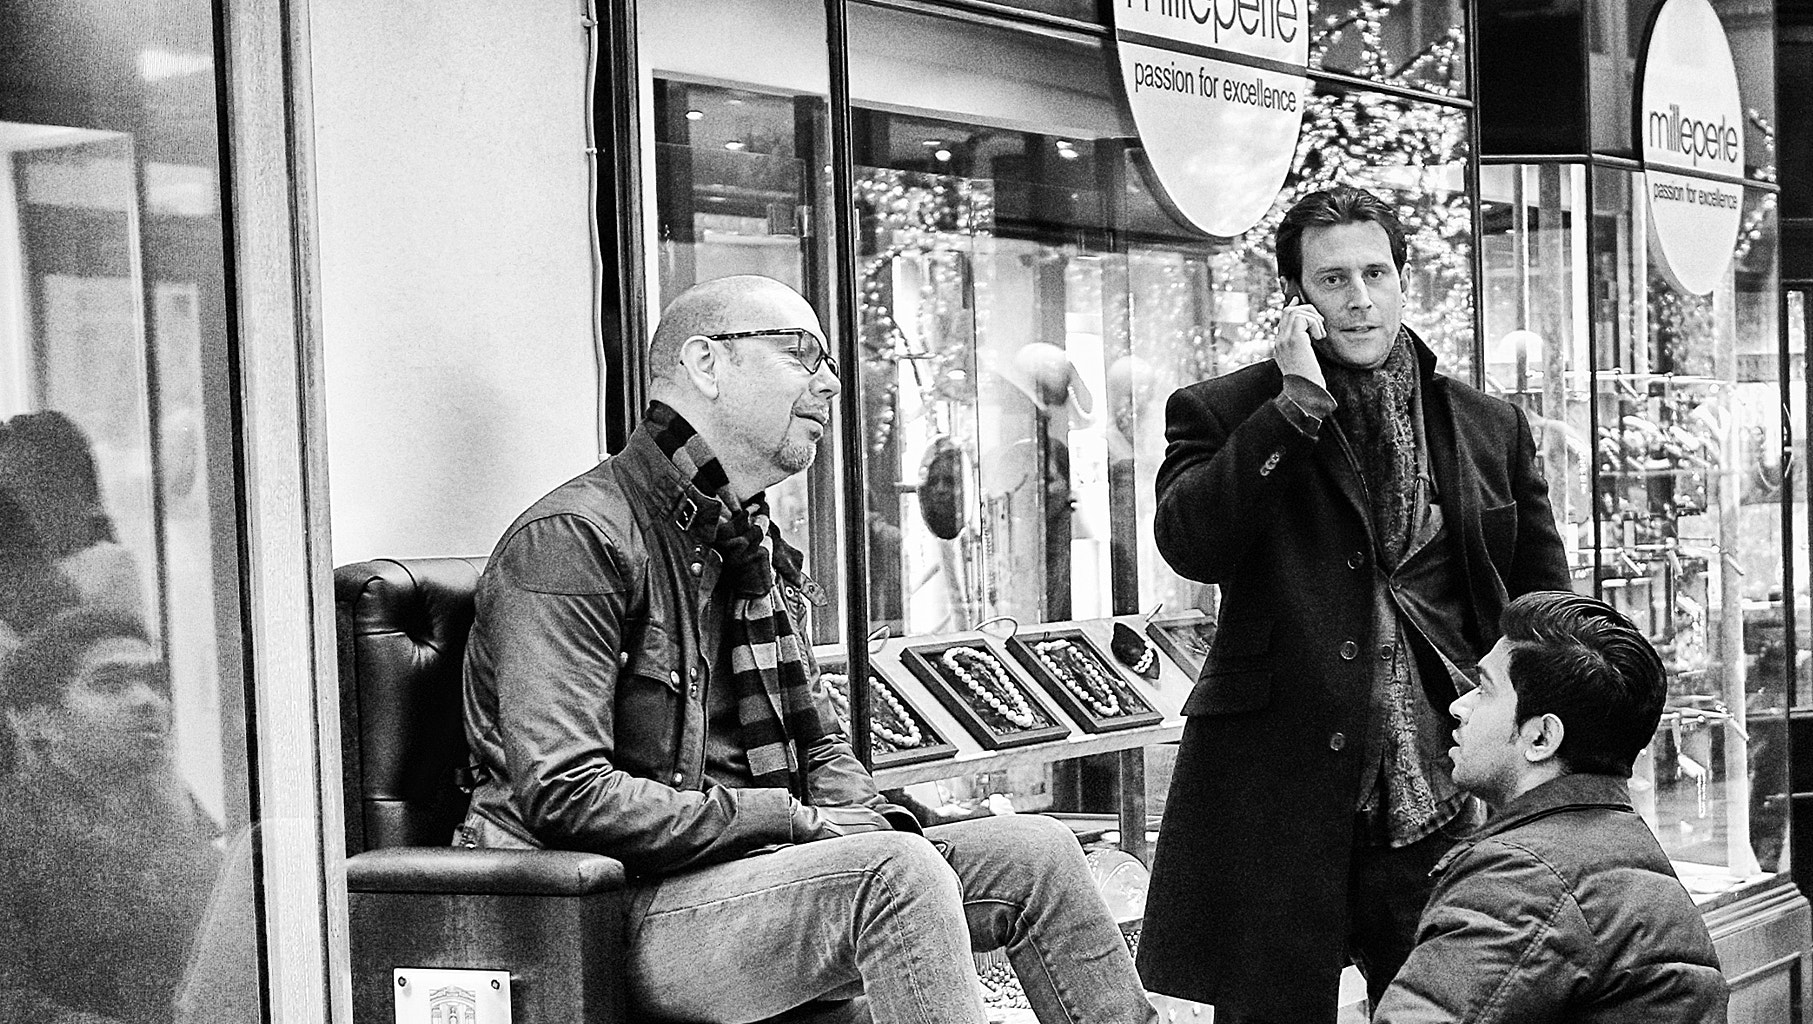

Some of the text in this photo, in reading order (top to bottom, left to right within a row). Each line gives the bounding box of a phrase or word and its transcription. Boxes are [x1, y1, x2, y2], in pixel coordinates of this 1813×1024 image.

[1127, 0, 1297, 43] perle
[1134, 61, 1297, 113] passion for excellence
[1649, 103, 1738, 167] milleperle
